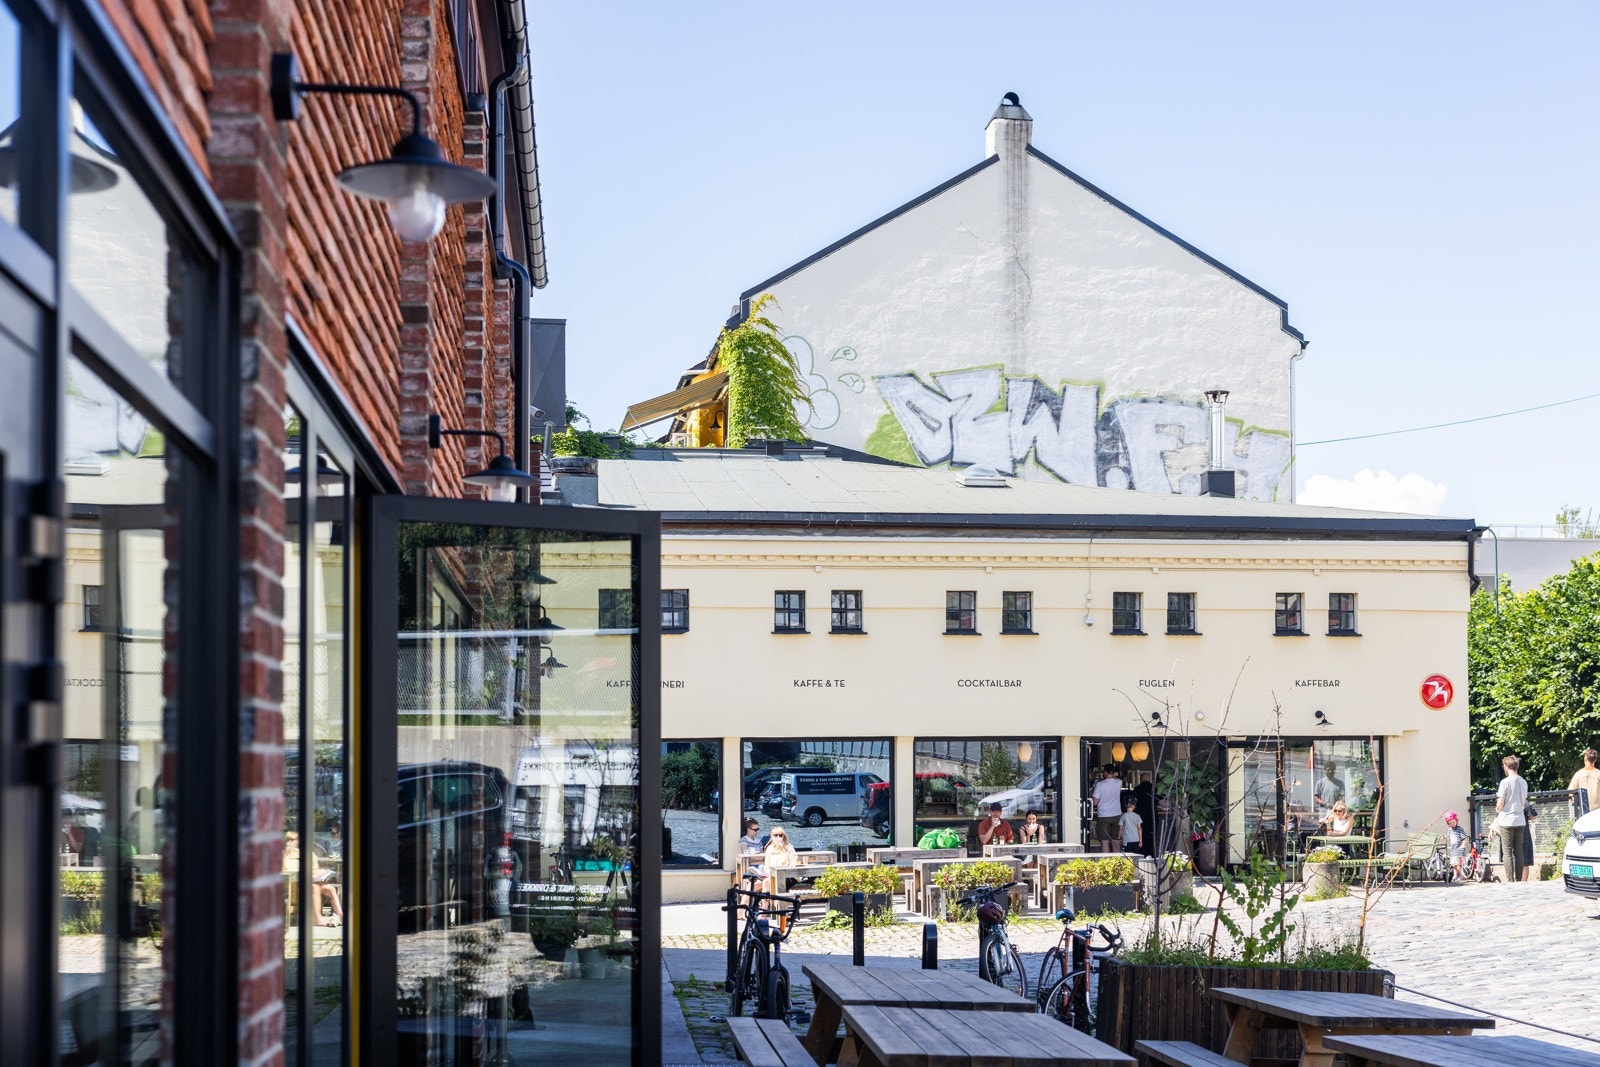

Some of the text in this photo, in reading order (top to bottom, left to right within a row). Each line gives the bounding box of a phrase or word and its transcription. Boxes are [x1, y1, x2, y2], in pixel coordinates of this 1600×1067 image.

[793, 679, 846, 688] KAFFE & TE
[957, 679, 1022, 688] COCKTAILBAR
[1139, 679, 1175, 688] FUGLEN
[1295, 679, 1340, 688] KAFFEBAR
